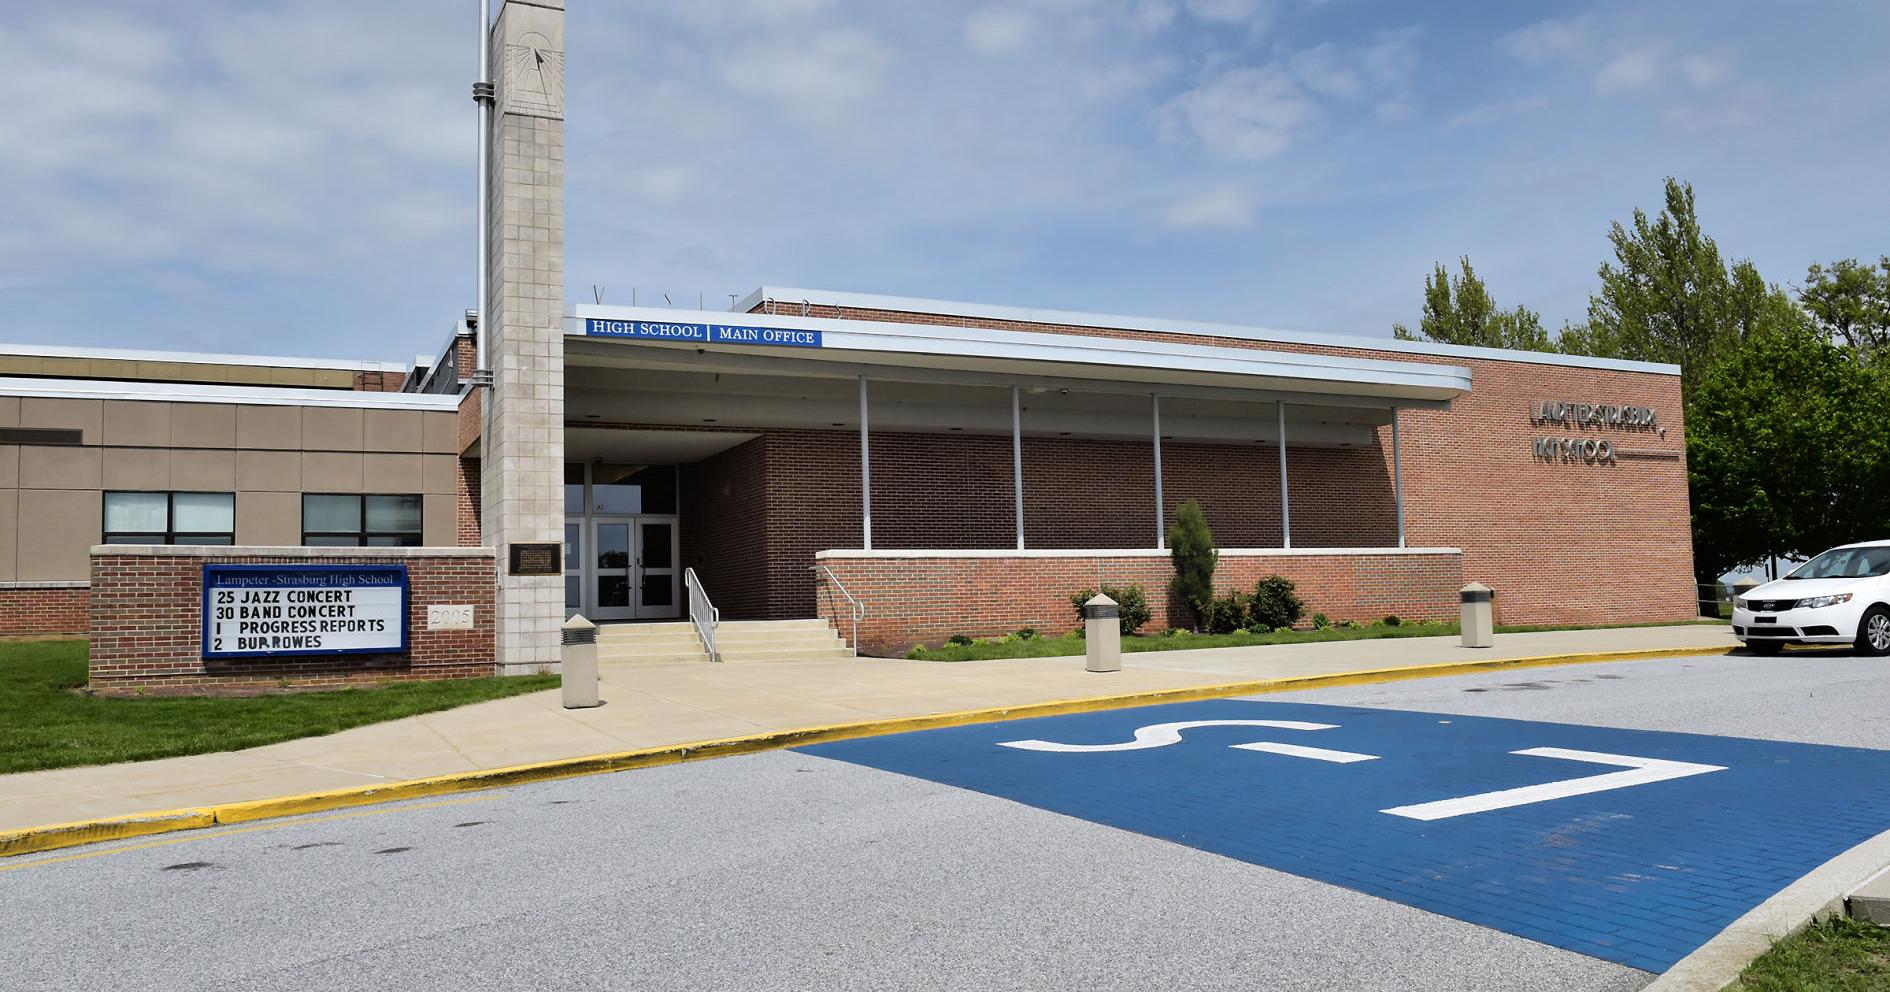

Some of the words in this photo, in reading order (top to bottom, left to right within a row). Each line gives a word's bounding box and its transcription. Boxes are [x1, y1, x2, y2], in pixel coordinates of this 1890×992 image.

[592, 320, 634, 335] HIGH
[640, 322, 703, 338] SCHOOL
[719, 327, 758, 341] MAIN
[763, 330, 815, 344] OFFICE
[217, 574, 269, 587] Lampeter
[330, 574, 355, 587] High
[358, 573, 393, 585] School
[217, 591, 235, 604] 25
[241, 591, 280, 604] JAZZ
[287, 590, 352, 603] CONCERT
[216, 607, 234, 620] 30
[240, 606, 281, 619] BAND
[288, 605, 355, 618] CONCERT
[431, 609, 471, 625] 2005
[240, 620, 317, 634] PROGRESS
[320, 619, 385, 633] REPORTS
[214, 638, 223, 651] 2
[238, 635, 321, 650] BURROWES
